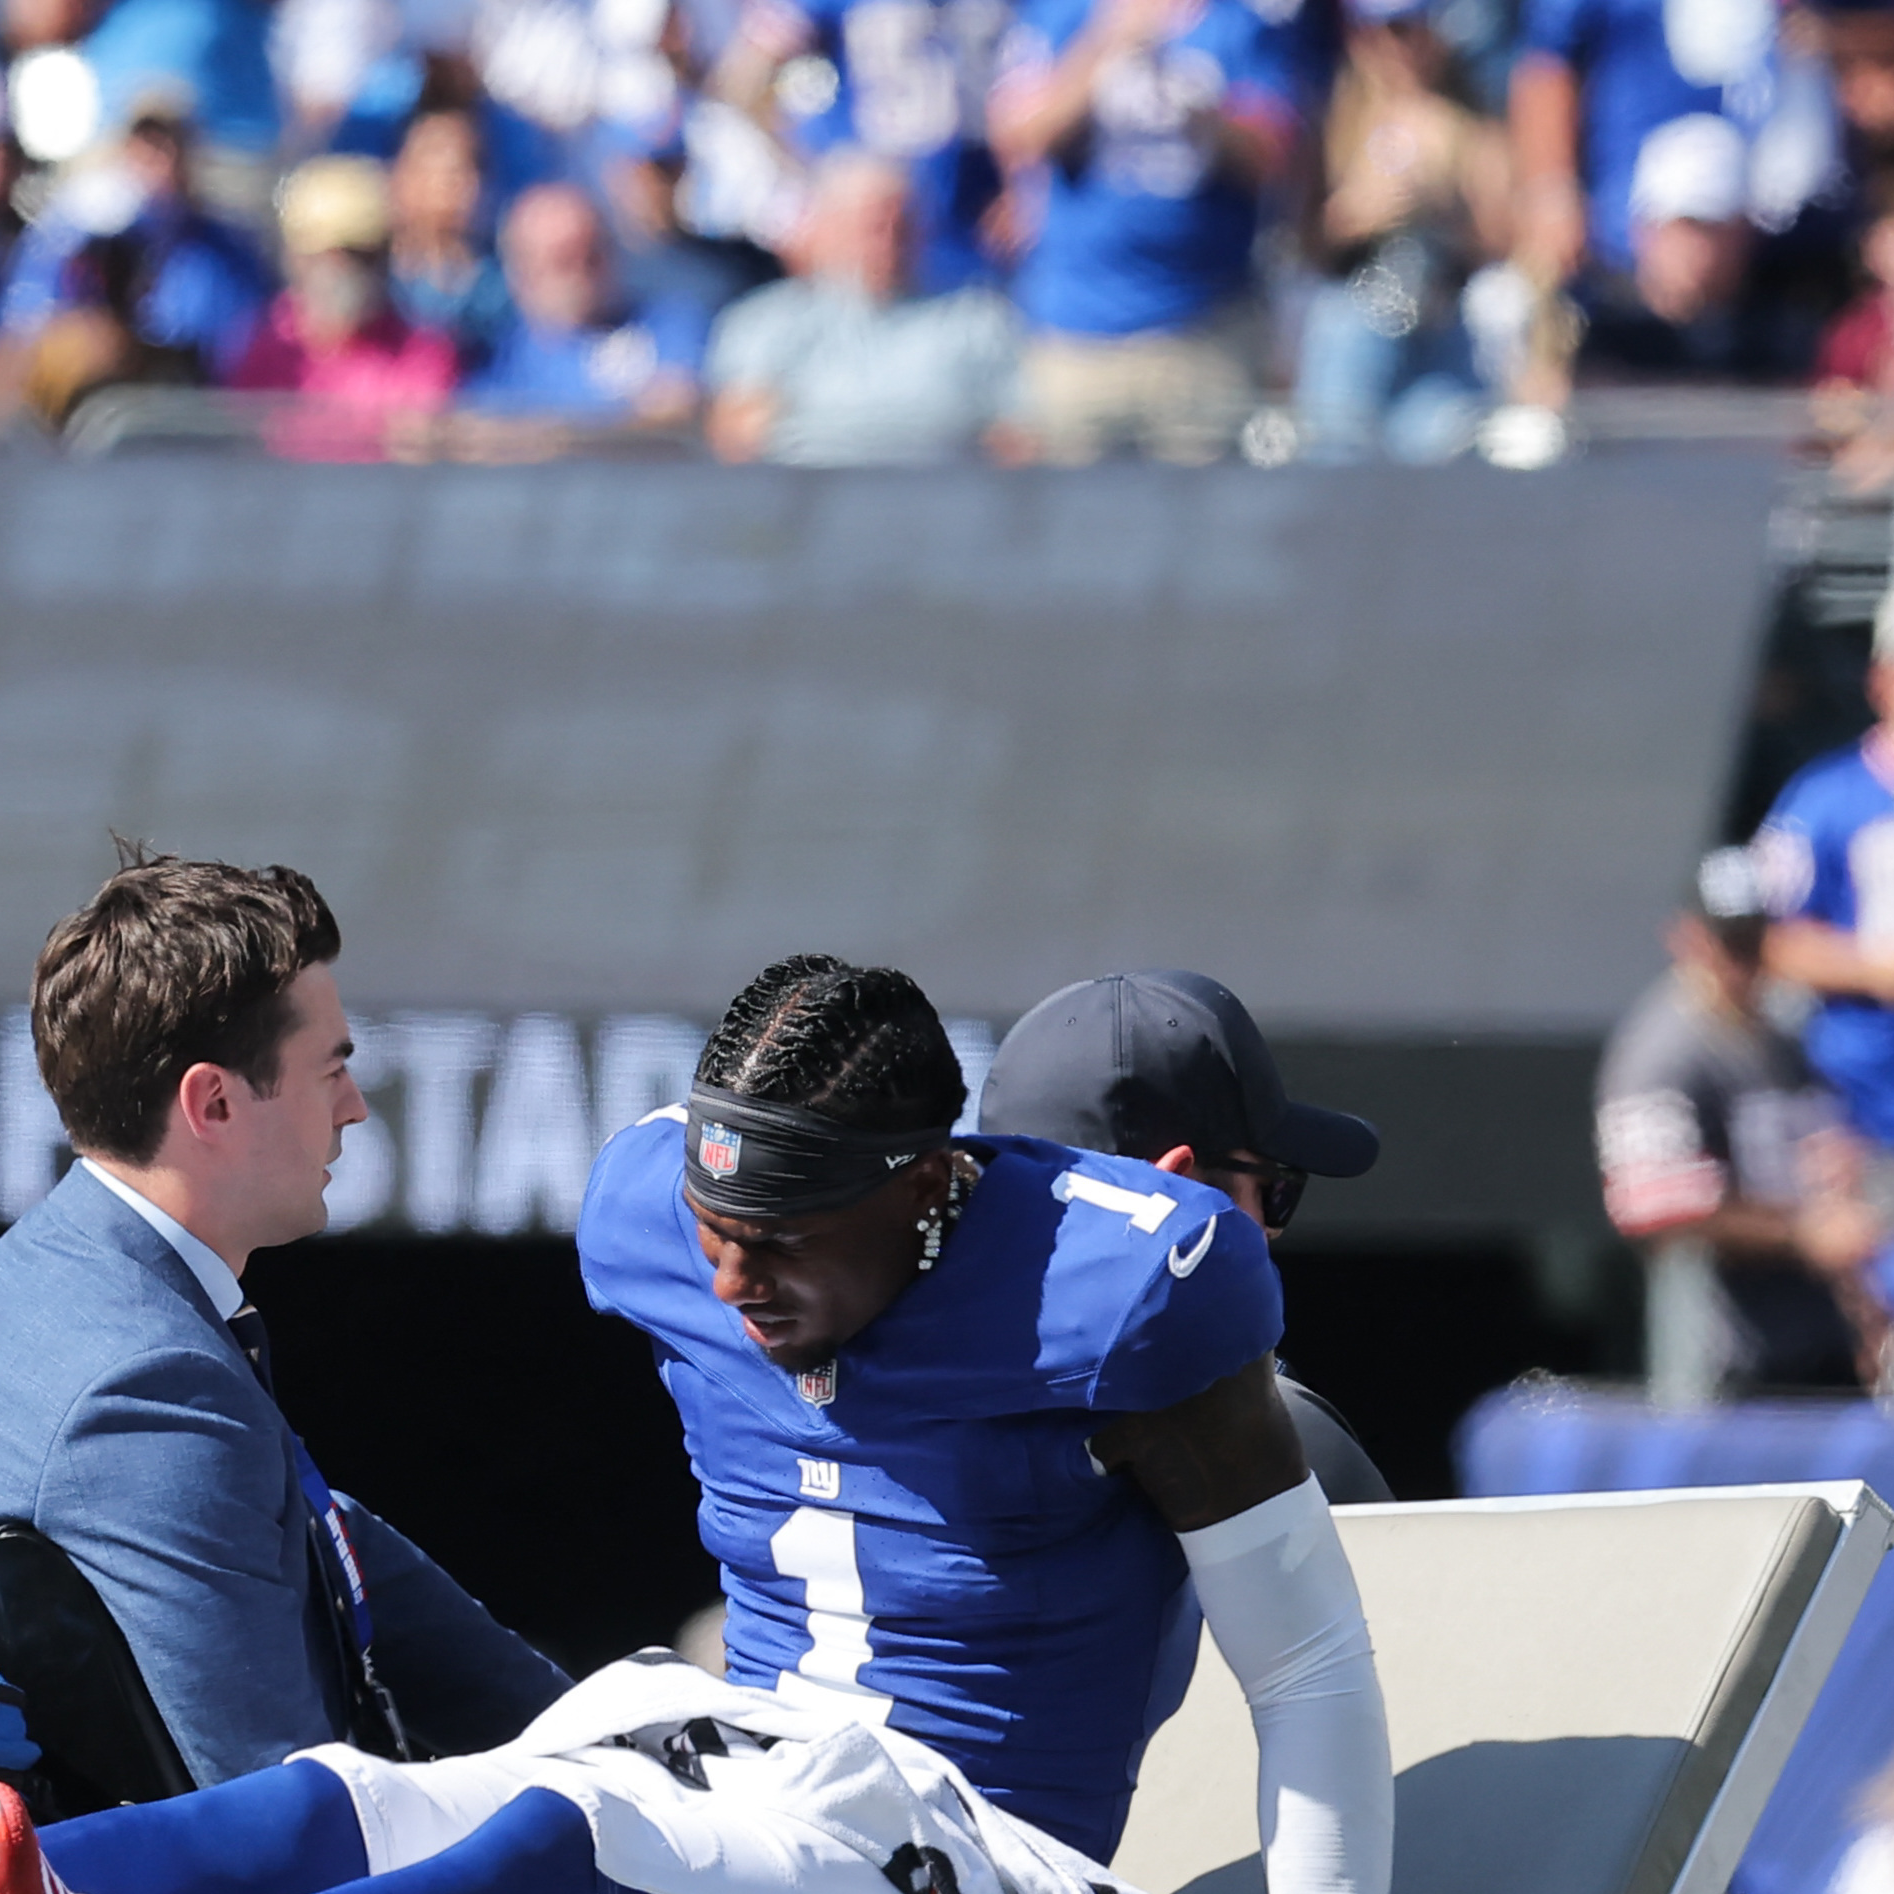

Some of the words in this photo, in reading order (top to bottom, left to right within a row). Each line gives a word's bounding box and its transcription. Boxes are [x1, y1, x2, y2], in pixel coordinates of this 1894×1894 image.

[703, 1142, 734, 1170] NFL
[1050, 1170, 1179, 1235] 1
[803, 1376, 830, 1397] NFL
[769, 1505, 895, 1727] 1
